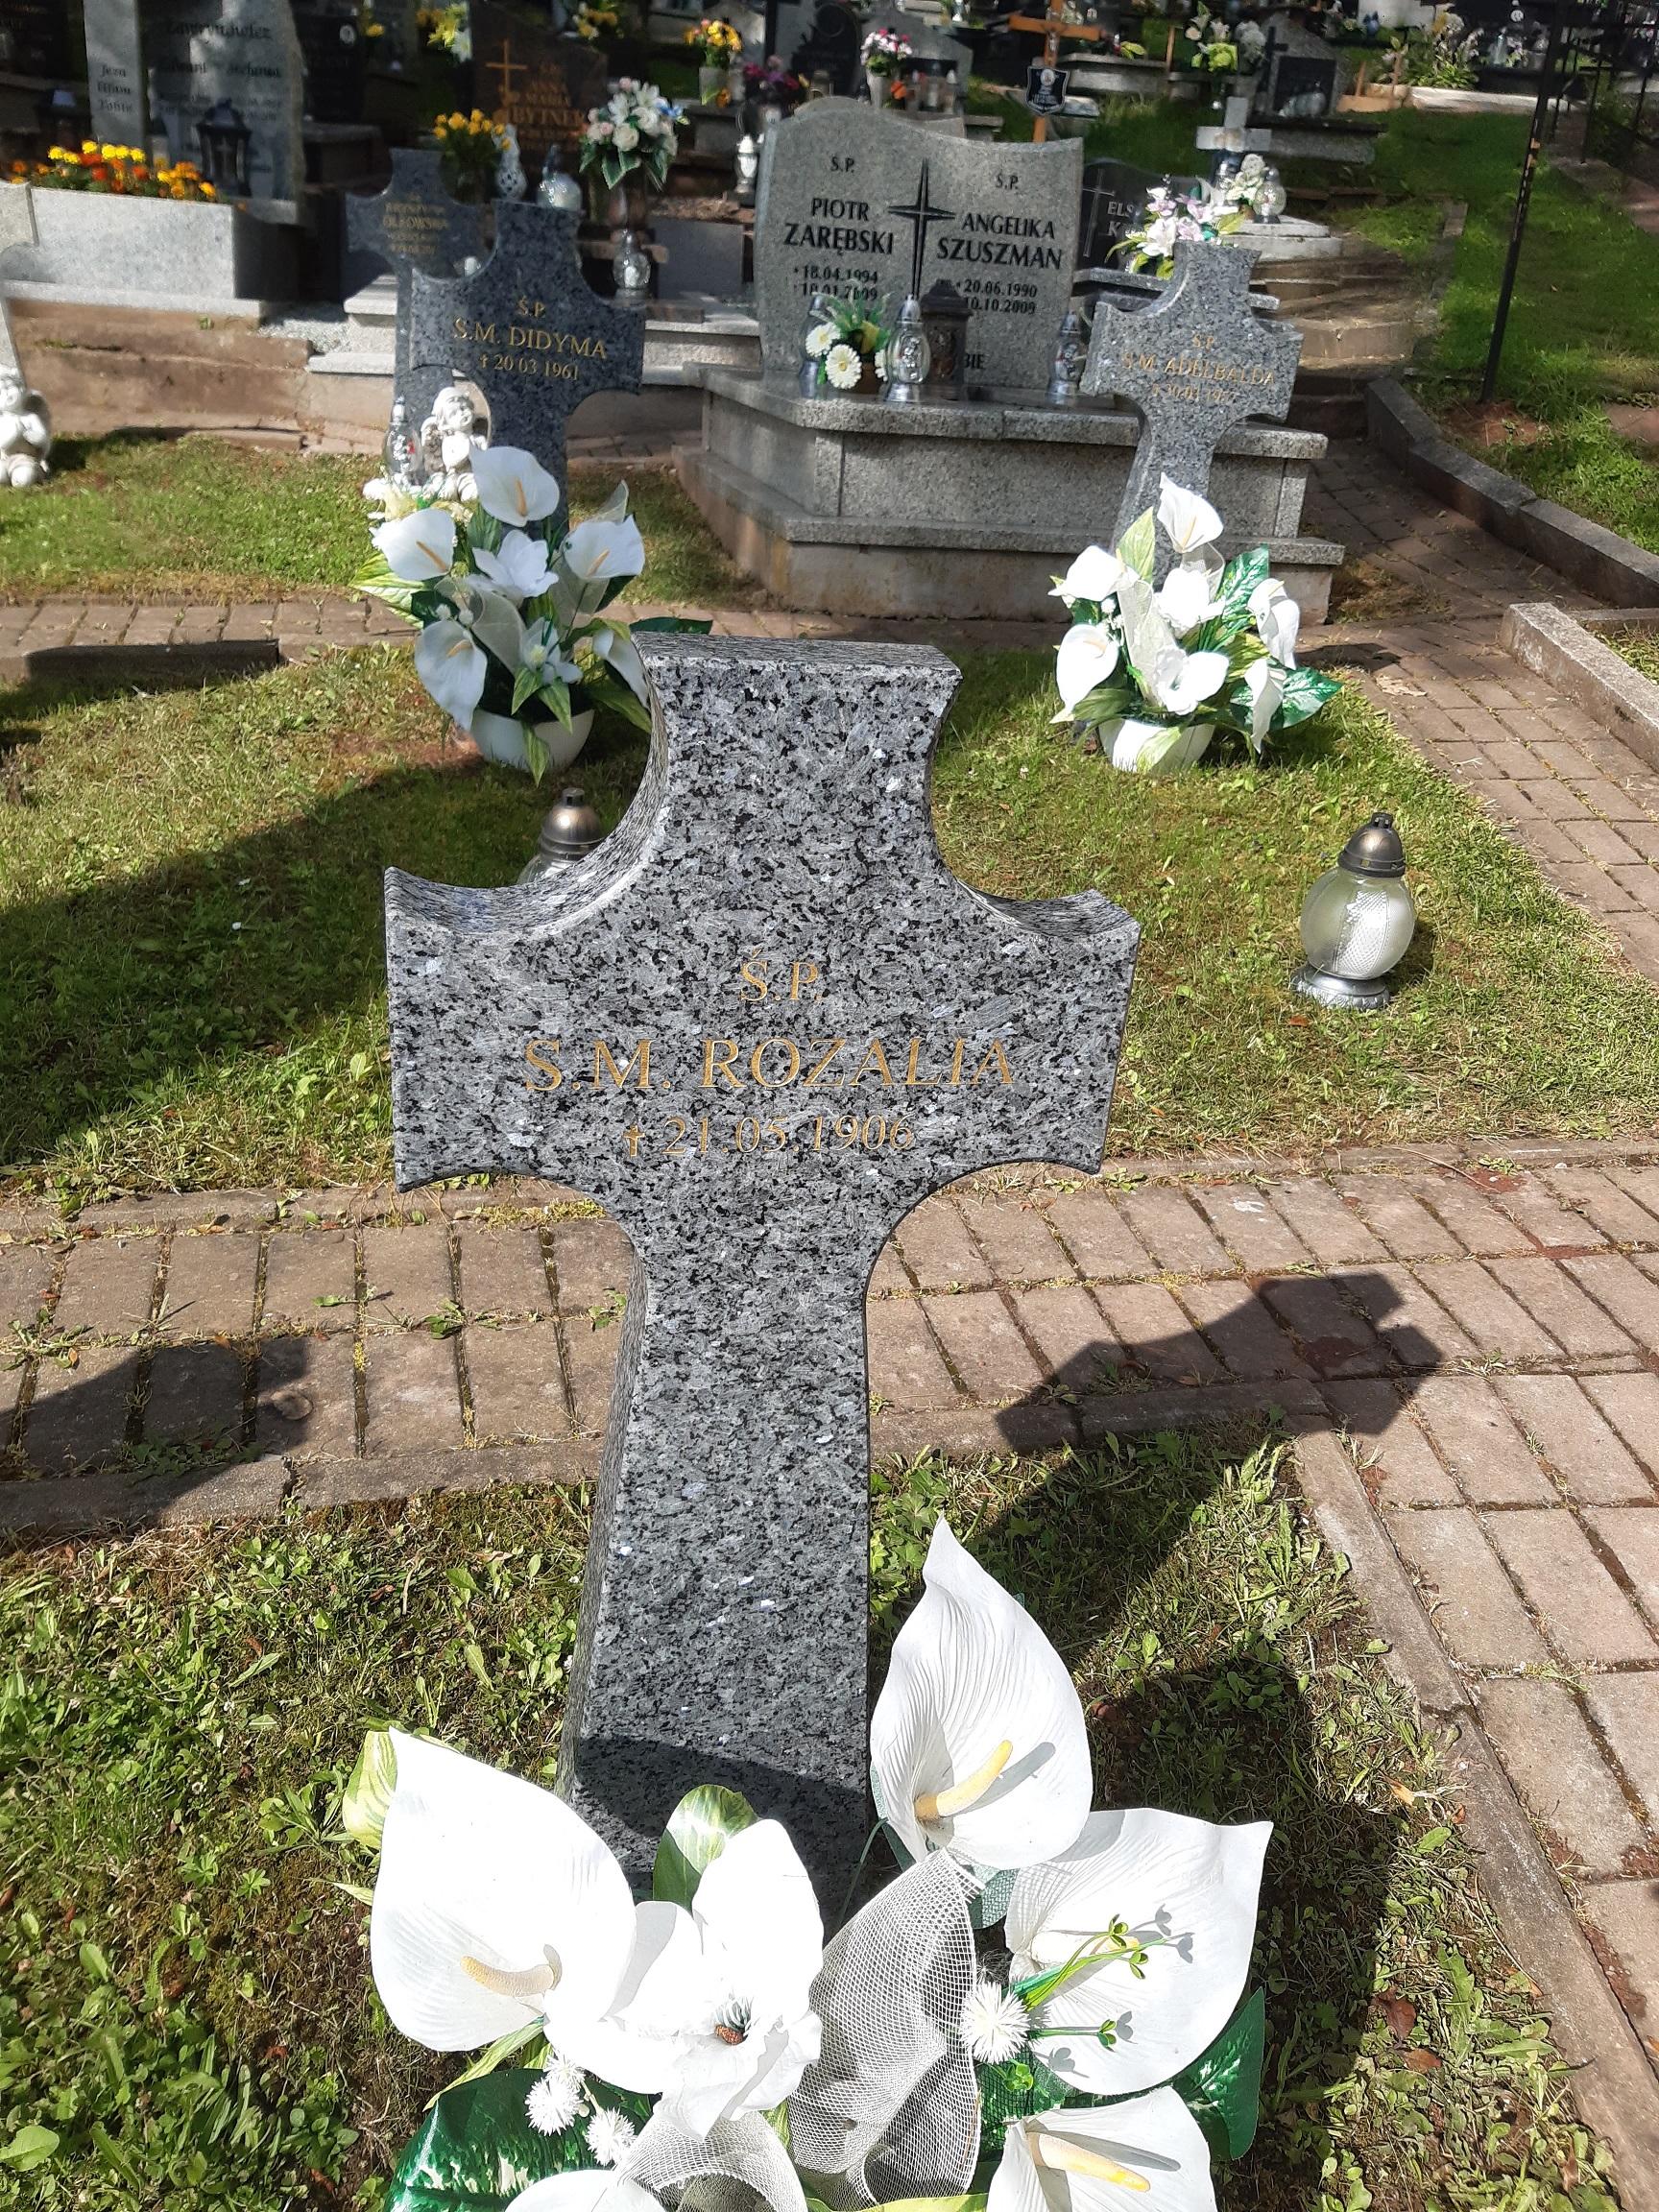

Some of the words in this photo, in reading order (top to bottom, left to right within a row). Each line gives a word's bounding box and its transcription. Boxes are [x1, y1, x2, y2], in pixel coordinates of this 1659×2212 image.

[810, 197, 870, 222] PIOTR
[961, 212, 1055, 240] ANGELIKA
[783, 222, 894, 256] ZARĘBSKI
[937, 237, 1063, 270] SZUSZMAN
[964, 278, 1038, 299] 20.06.1990
[453, 318, 500, 344] S.M.
[509, 325, 608, 360] DIDYMA
[1163, 355, 1276, 386] ADELBALDA
[741, 949, 823, 1001] Ś.P.
[524, 1038, 672, 1092] S.M.
[699, 1037, 1017, 1090] ROZALIA
[663, 1112, 915, 1156] 21.05.1906
